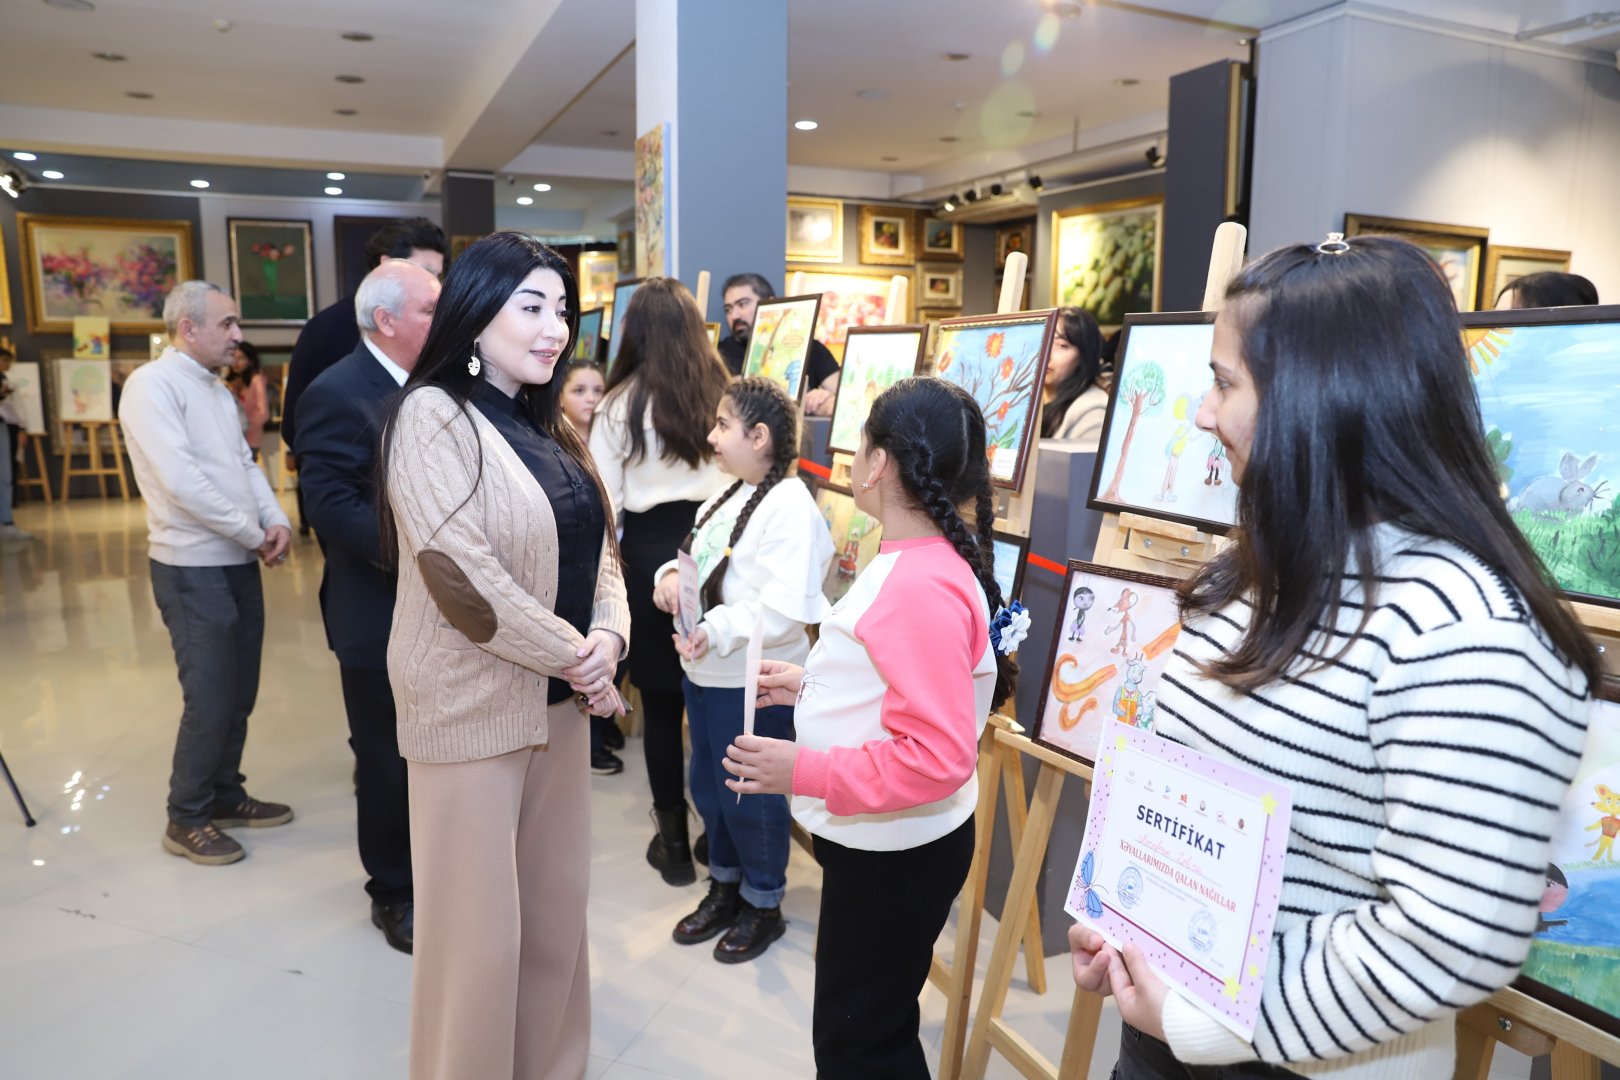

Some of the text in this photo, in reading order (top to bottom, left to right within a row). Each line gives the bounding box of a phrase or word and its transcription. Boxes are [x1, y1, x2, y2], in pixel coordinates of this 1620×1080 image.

[1137, 804, 1225, 860] SERTİFİKAT
[1120, 839, 1174, 878] XƏYALLARIMIZDA
[1175, 871, 1198, 891] QALAN
[1199, 884, 1237, 913] NAĞILLAR
